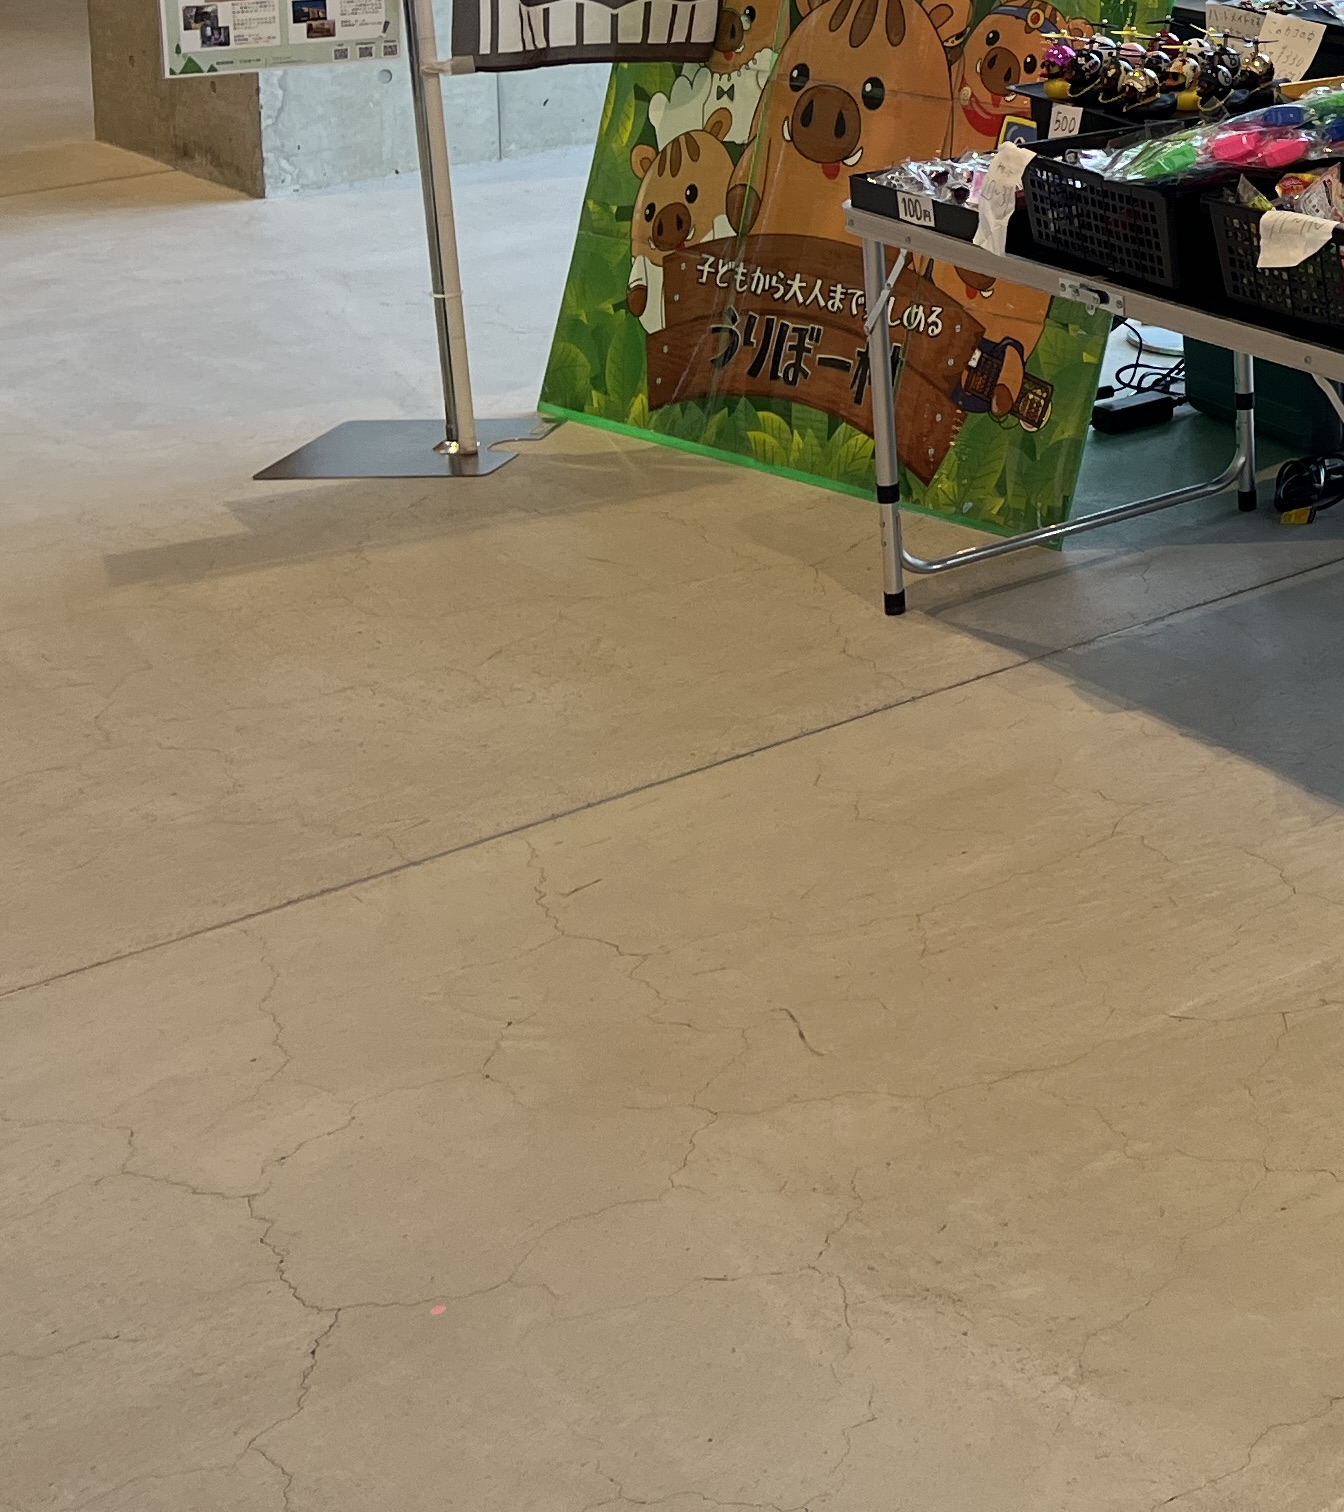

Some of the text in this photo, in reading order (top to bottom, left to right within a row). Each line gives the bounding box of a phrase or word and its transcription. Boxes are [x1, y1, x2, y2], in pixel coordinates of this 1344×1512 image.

[1052, 110, 1077, 135] 500
[696, 256, 943, 336] 子どもから大人までしめる
